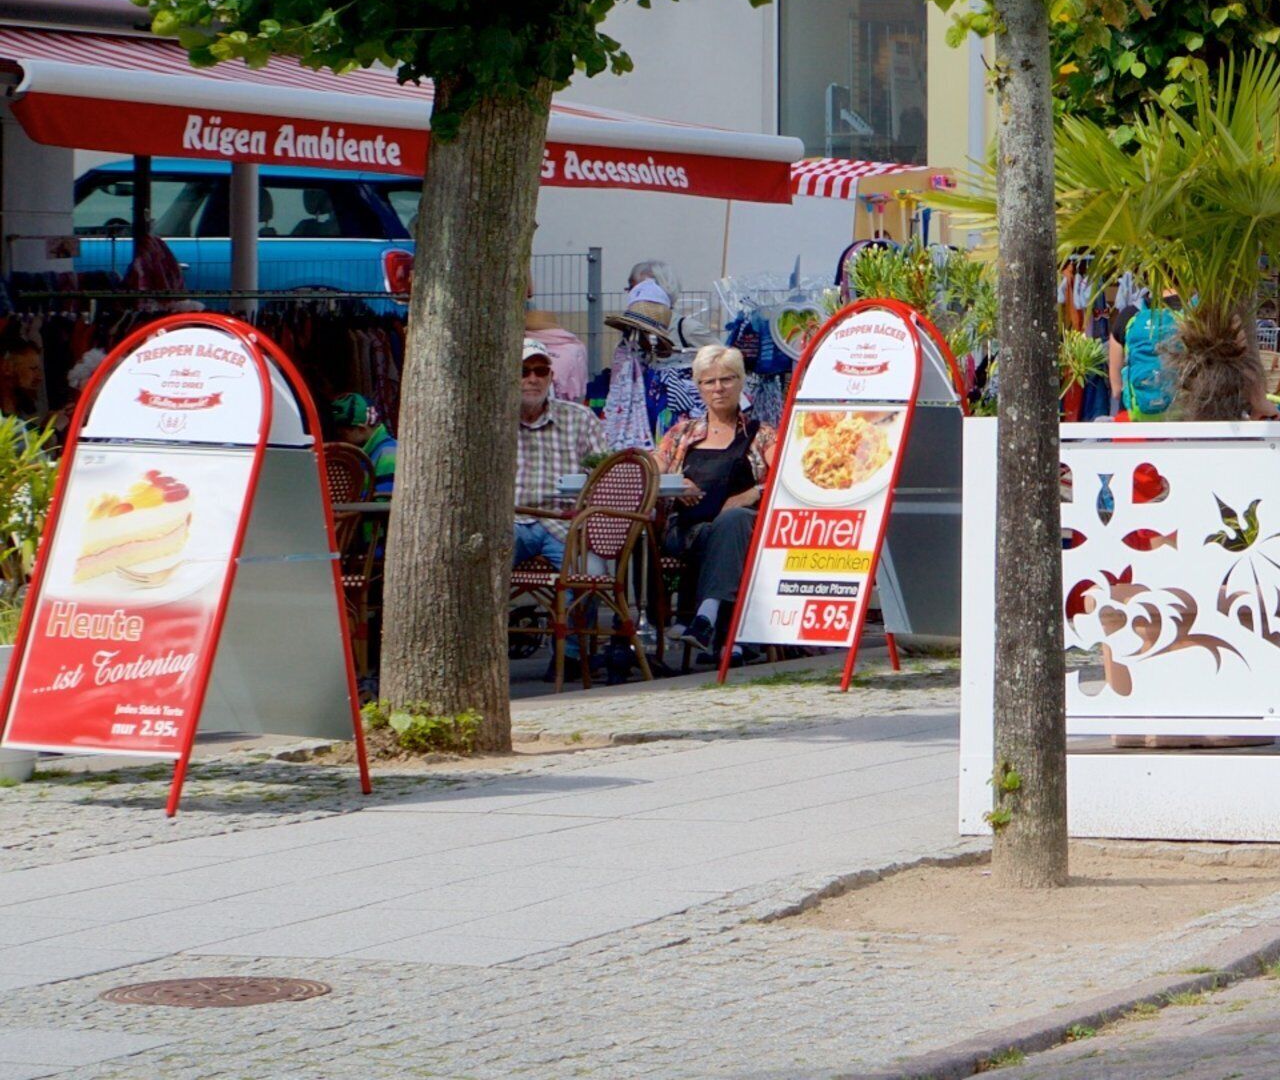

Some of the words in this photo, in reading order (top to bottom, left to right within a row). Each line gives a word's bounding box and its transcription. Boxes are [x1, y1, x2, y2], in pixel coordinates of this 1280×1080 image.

[183, 114, 266, 156] Rügen
[273, 124, 401, 167] Ambiente
[564, 150, 689, 188] Accessoires
[834, 324, 872, 341] TREPPEN
[873, 323, 907, 341] BÄCKER
[136, 344, 194, 364] TREPPEN
[195, 343, 247, 367] BÄCKER
[771, 511, 863, 547] Rührei
[785, 555, 807, 569] mit
[810, 552, 870, 570] Schinken
[800, 584, 814, 594] aus
[815, 583, 829, 594] der
[830, 583, 858, 595] Pfanne
[46, 601, 144, 642] Heute
[770, 608, 799, 626] nur
[92, 649, 199, 687] Tortentag
[111, 723, 137, 736] nur
